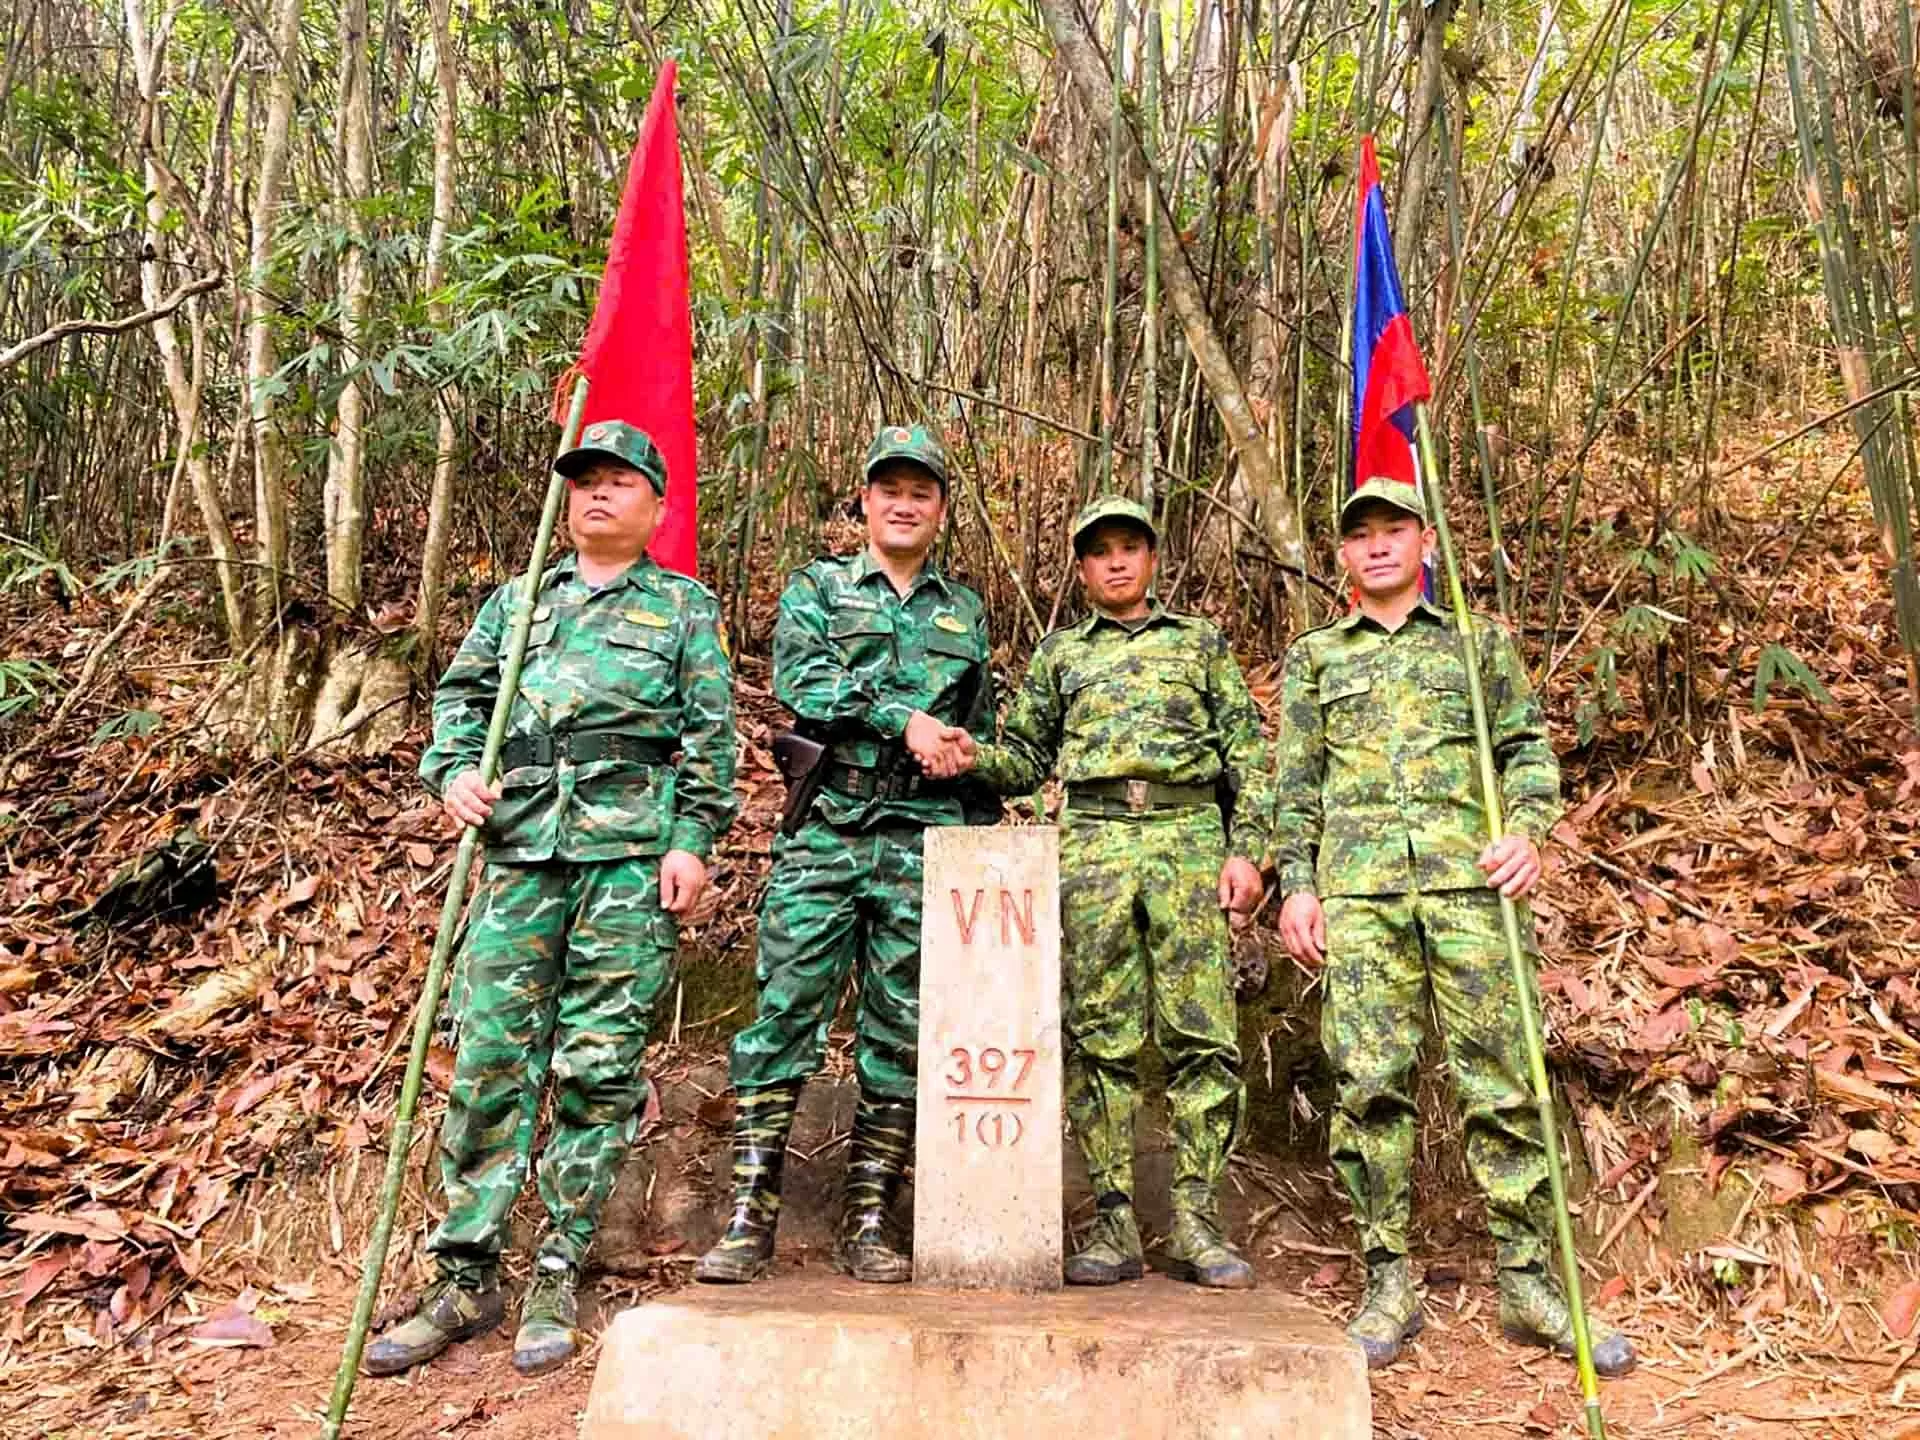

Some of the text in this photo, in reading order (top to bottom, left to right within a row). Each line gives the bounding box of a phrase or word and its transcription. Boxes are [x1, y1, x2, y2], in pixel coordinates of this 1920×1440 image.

[950, 888, 1033, 944] VN
[945, 1047, 1036, 1091] 397
[955, 1111, 1023, 1146] 1(1)
